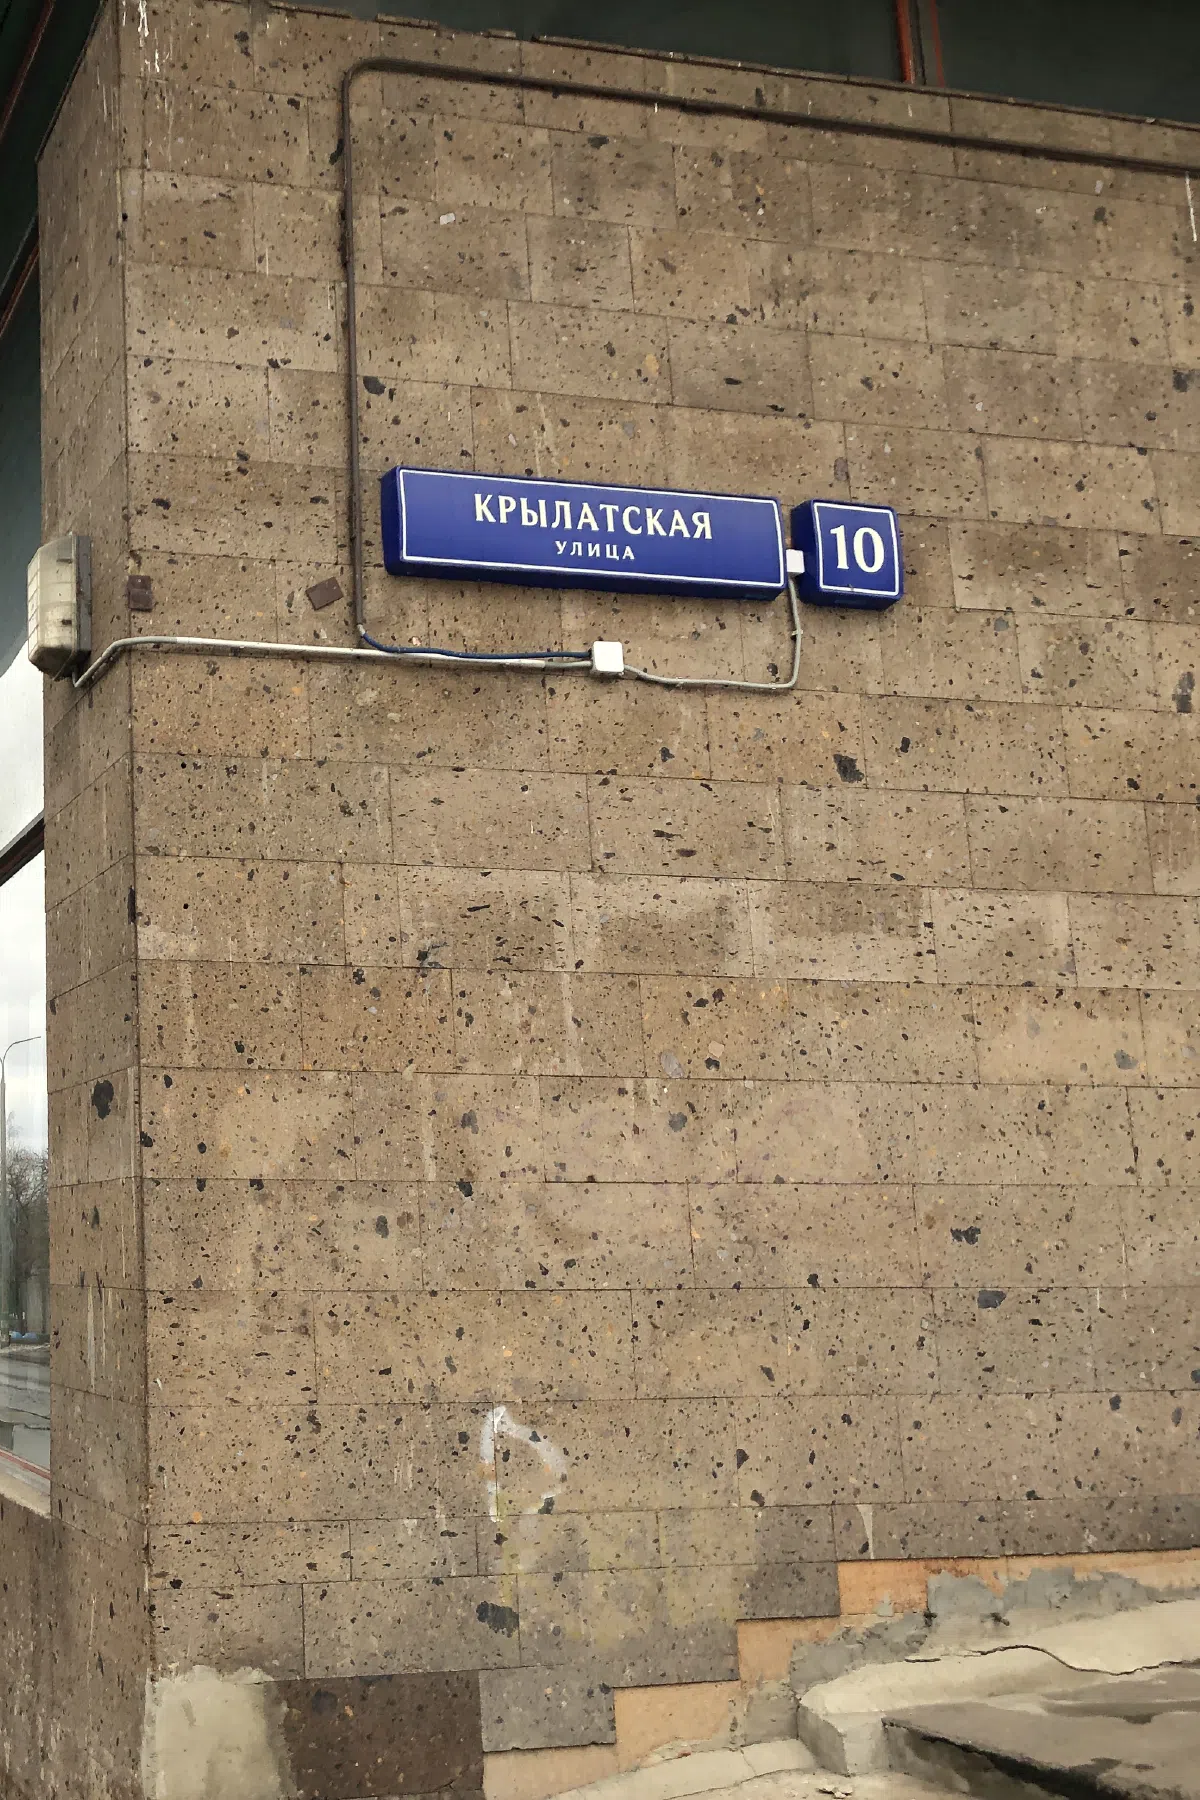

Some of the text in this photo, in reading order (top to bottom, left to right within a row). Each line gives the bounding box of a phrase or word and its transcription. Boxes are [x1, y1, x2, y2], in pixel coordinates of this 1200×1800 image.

[474, 493, 712, 539] КРЫЛАТСКАЯ
[555, 541, 635, 560] УЛИЦА
[830, 525, 884, 573] 10
